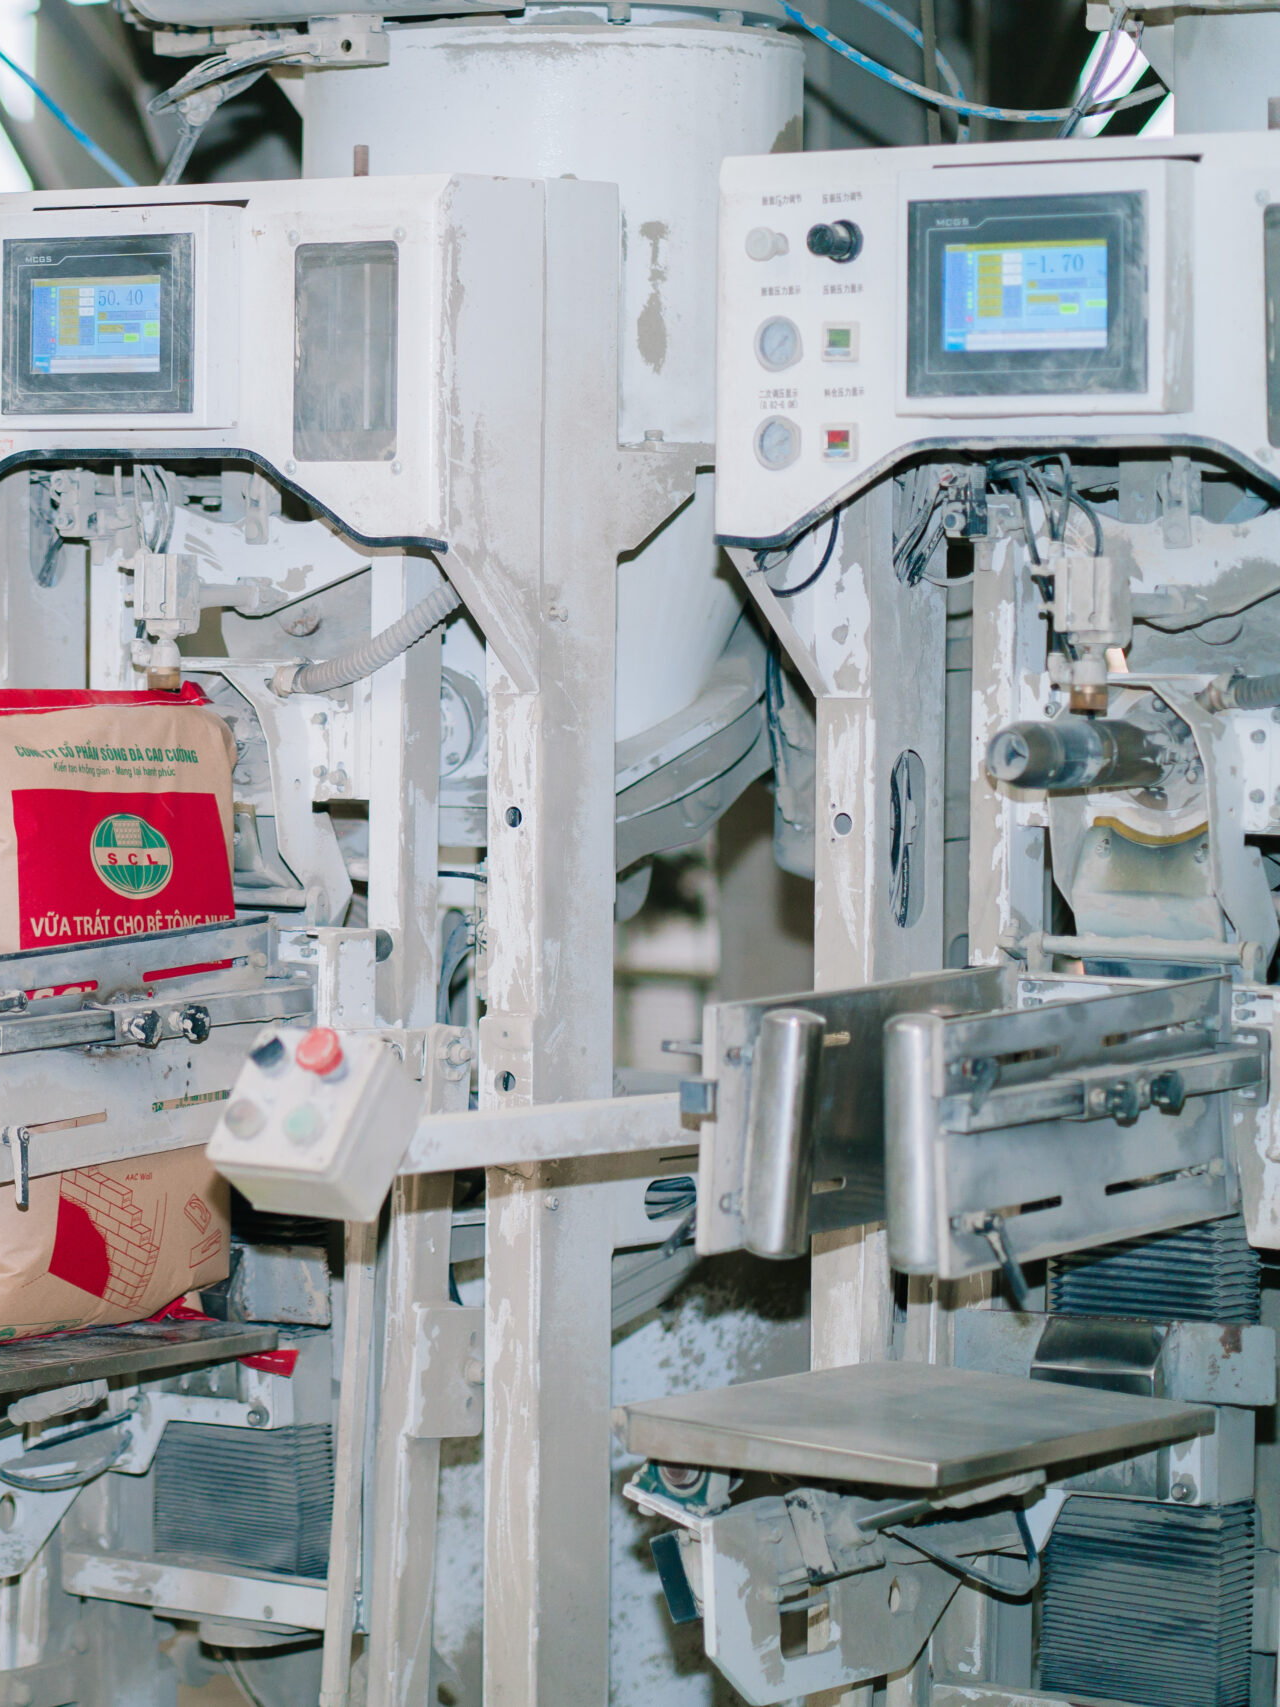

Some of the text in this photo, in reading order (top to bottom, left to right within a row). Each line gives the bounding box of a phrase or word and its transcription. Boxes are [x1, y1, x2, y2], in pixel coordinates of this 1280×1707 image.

[24, 255, 53, 264] MCGS
[98, 288, 145, 307] 50.40
[100, 743, 128, 762] SÔNG
[145, 747, 163, 763] CAO
[30, 911, 72, 938] VỮA
[73, 908, 111, 937] TRÁT
[114, 915, 144, 936] CHO
[125, 1172, 153, 1182] AAC Wall
